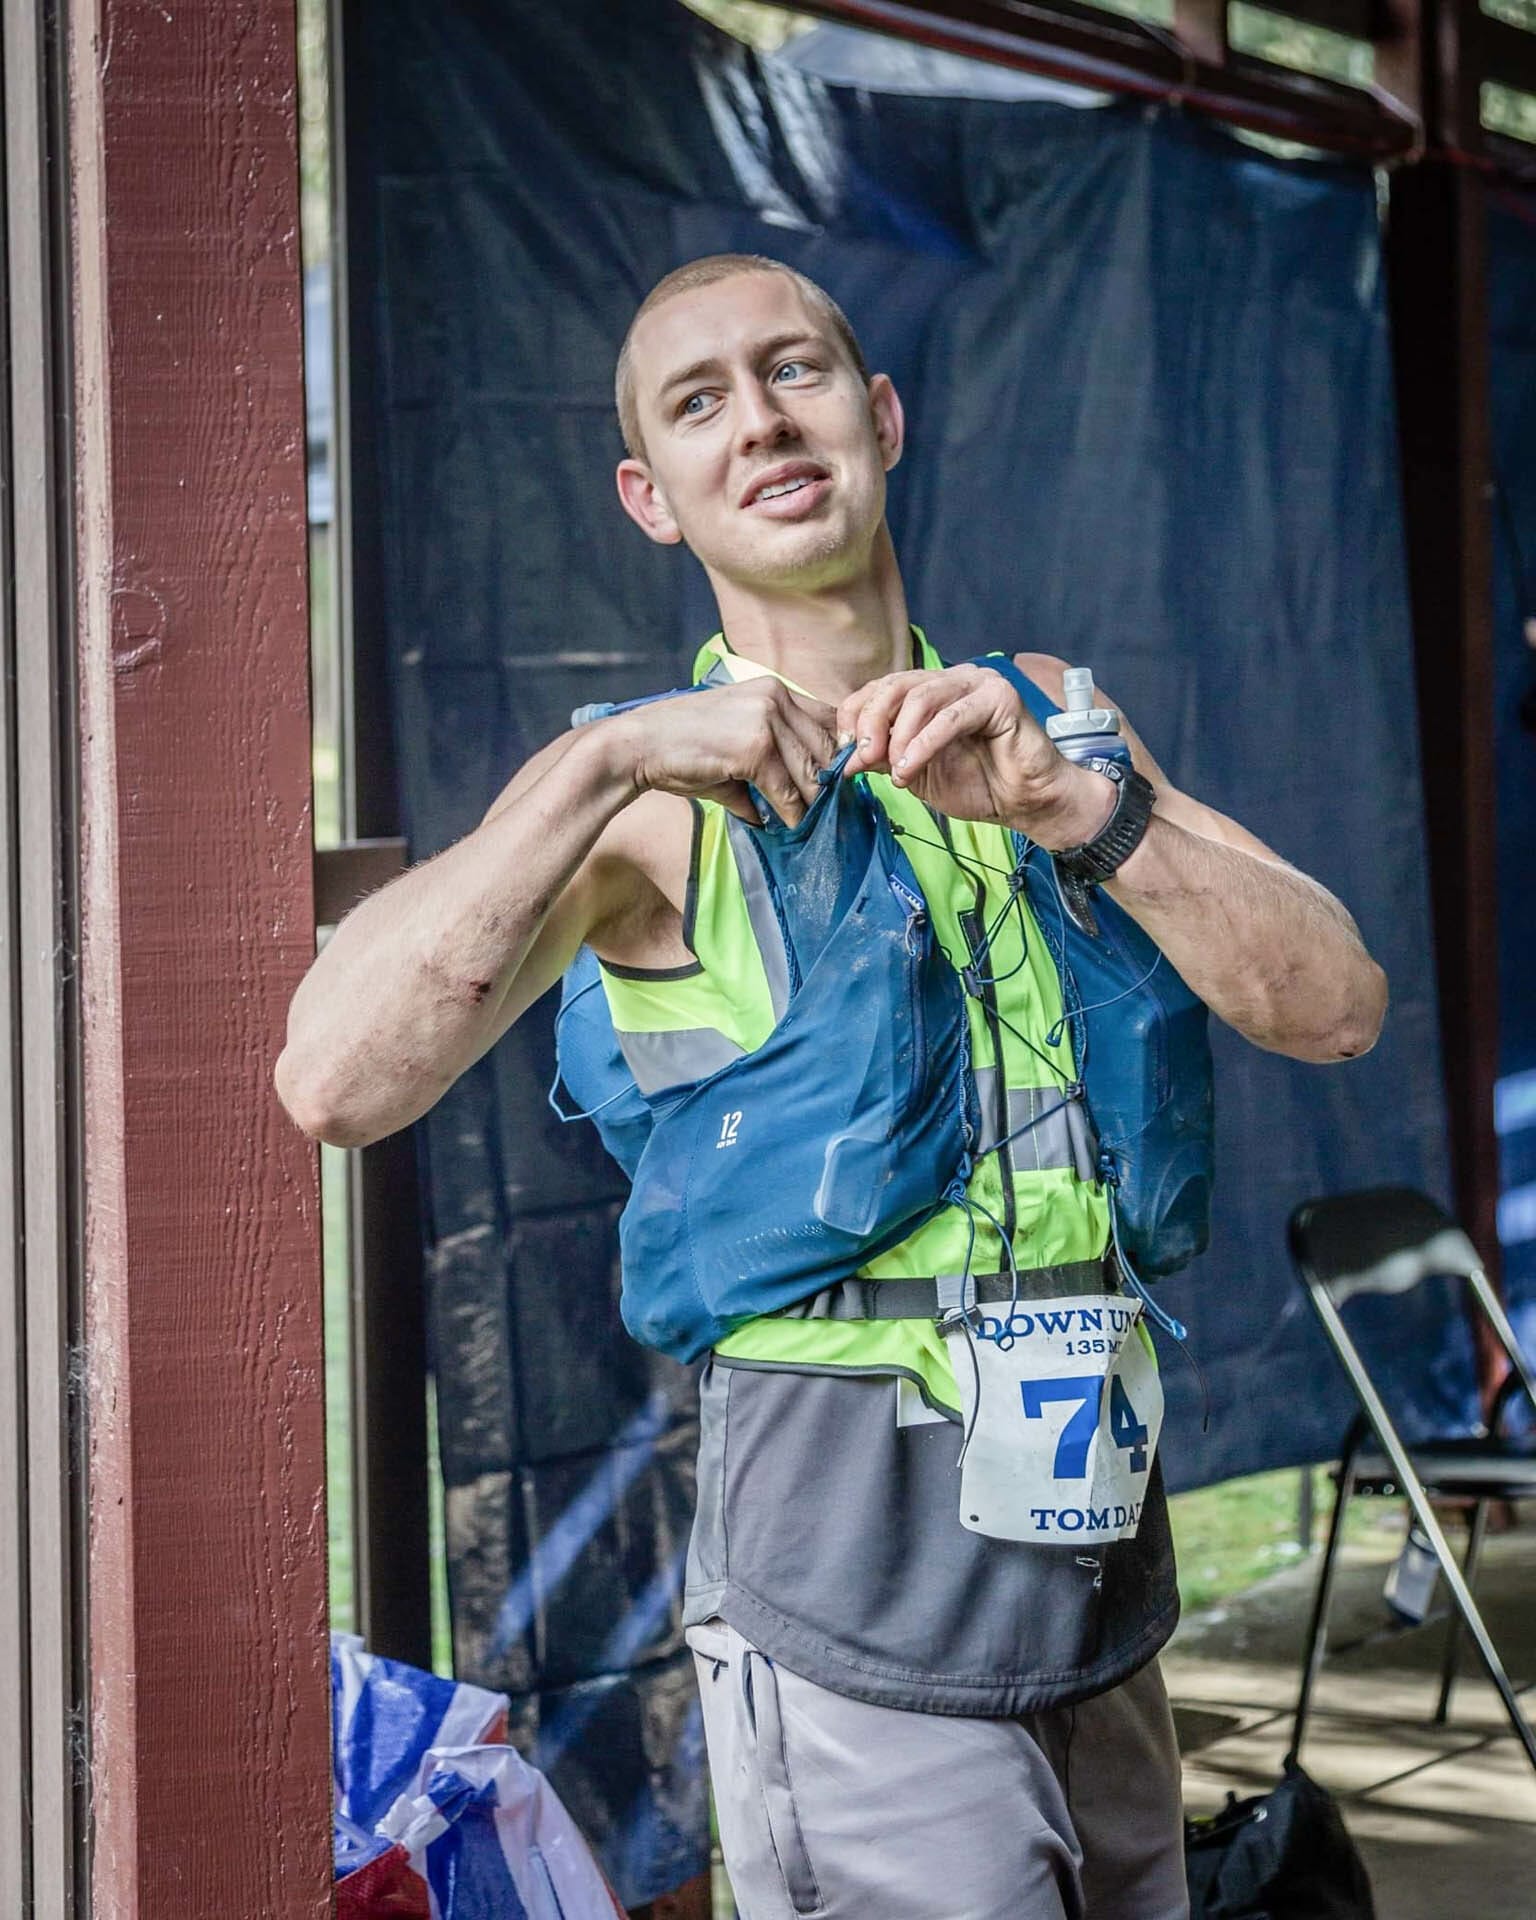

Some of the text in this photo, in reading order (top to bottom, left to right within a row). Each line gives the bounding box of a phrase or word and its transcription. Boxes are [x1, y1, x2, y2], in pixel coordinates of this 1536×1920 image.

[721, 1111, 743, 1140] 12
[978, 1308, 1102, 1339] DOWN
[1066, 1339, 1105, 1355] 135
[1020, 1374, 1148, 1479] 74
[1030, 1507, 1110, 1531] TOM
